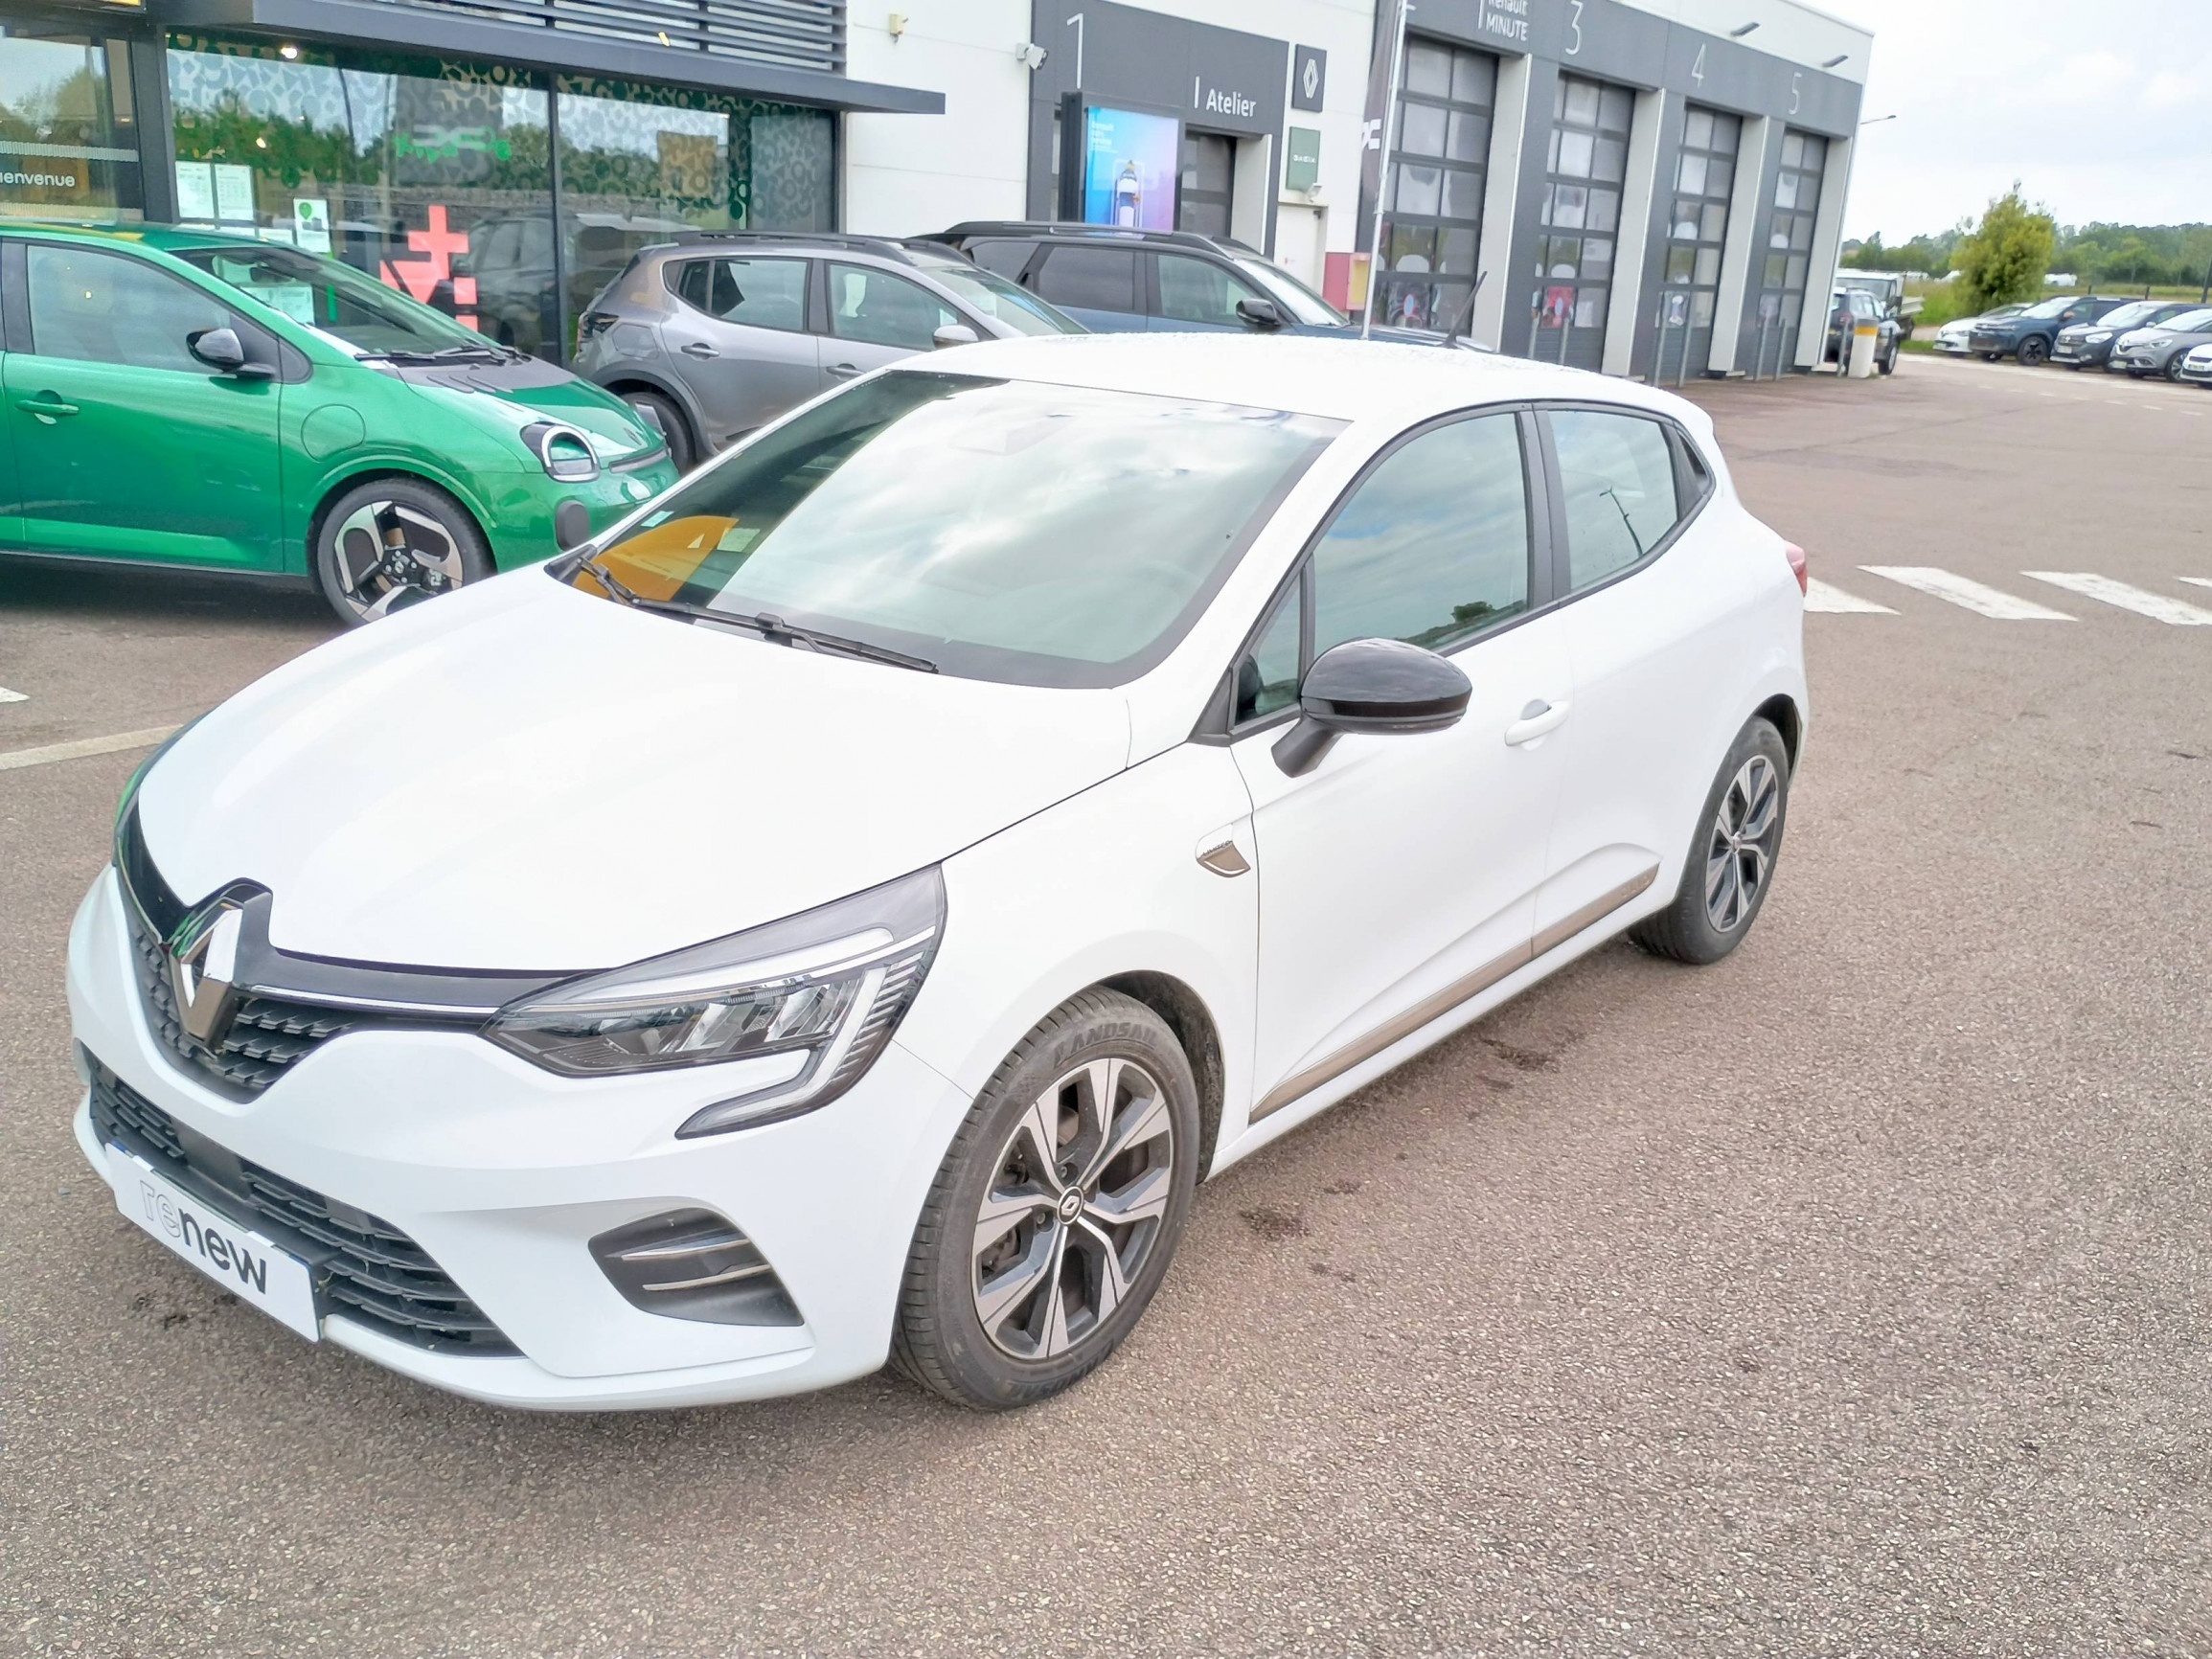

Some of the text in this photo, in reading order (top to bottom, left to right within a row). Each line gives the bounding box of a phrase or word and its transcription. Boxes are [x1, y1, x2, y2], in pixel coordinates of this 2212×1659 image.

[1486, 11, 1530, 41] MINUTE
[1564, 0, 1584, 56] 3
[1066, 12, 1083, 90] 1
[1691, 42, 1707, 88] 4
[1205, 88, 1257, 117] Atelier
[1789, 72, 1803, 115] 5
[140, 1179, 267, 1295] renew
